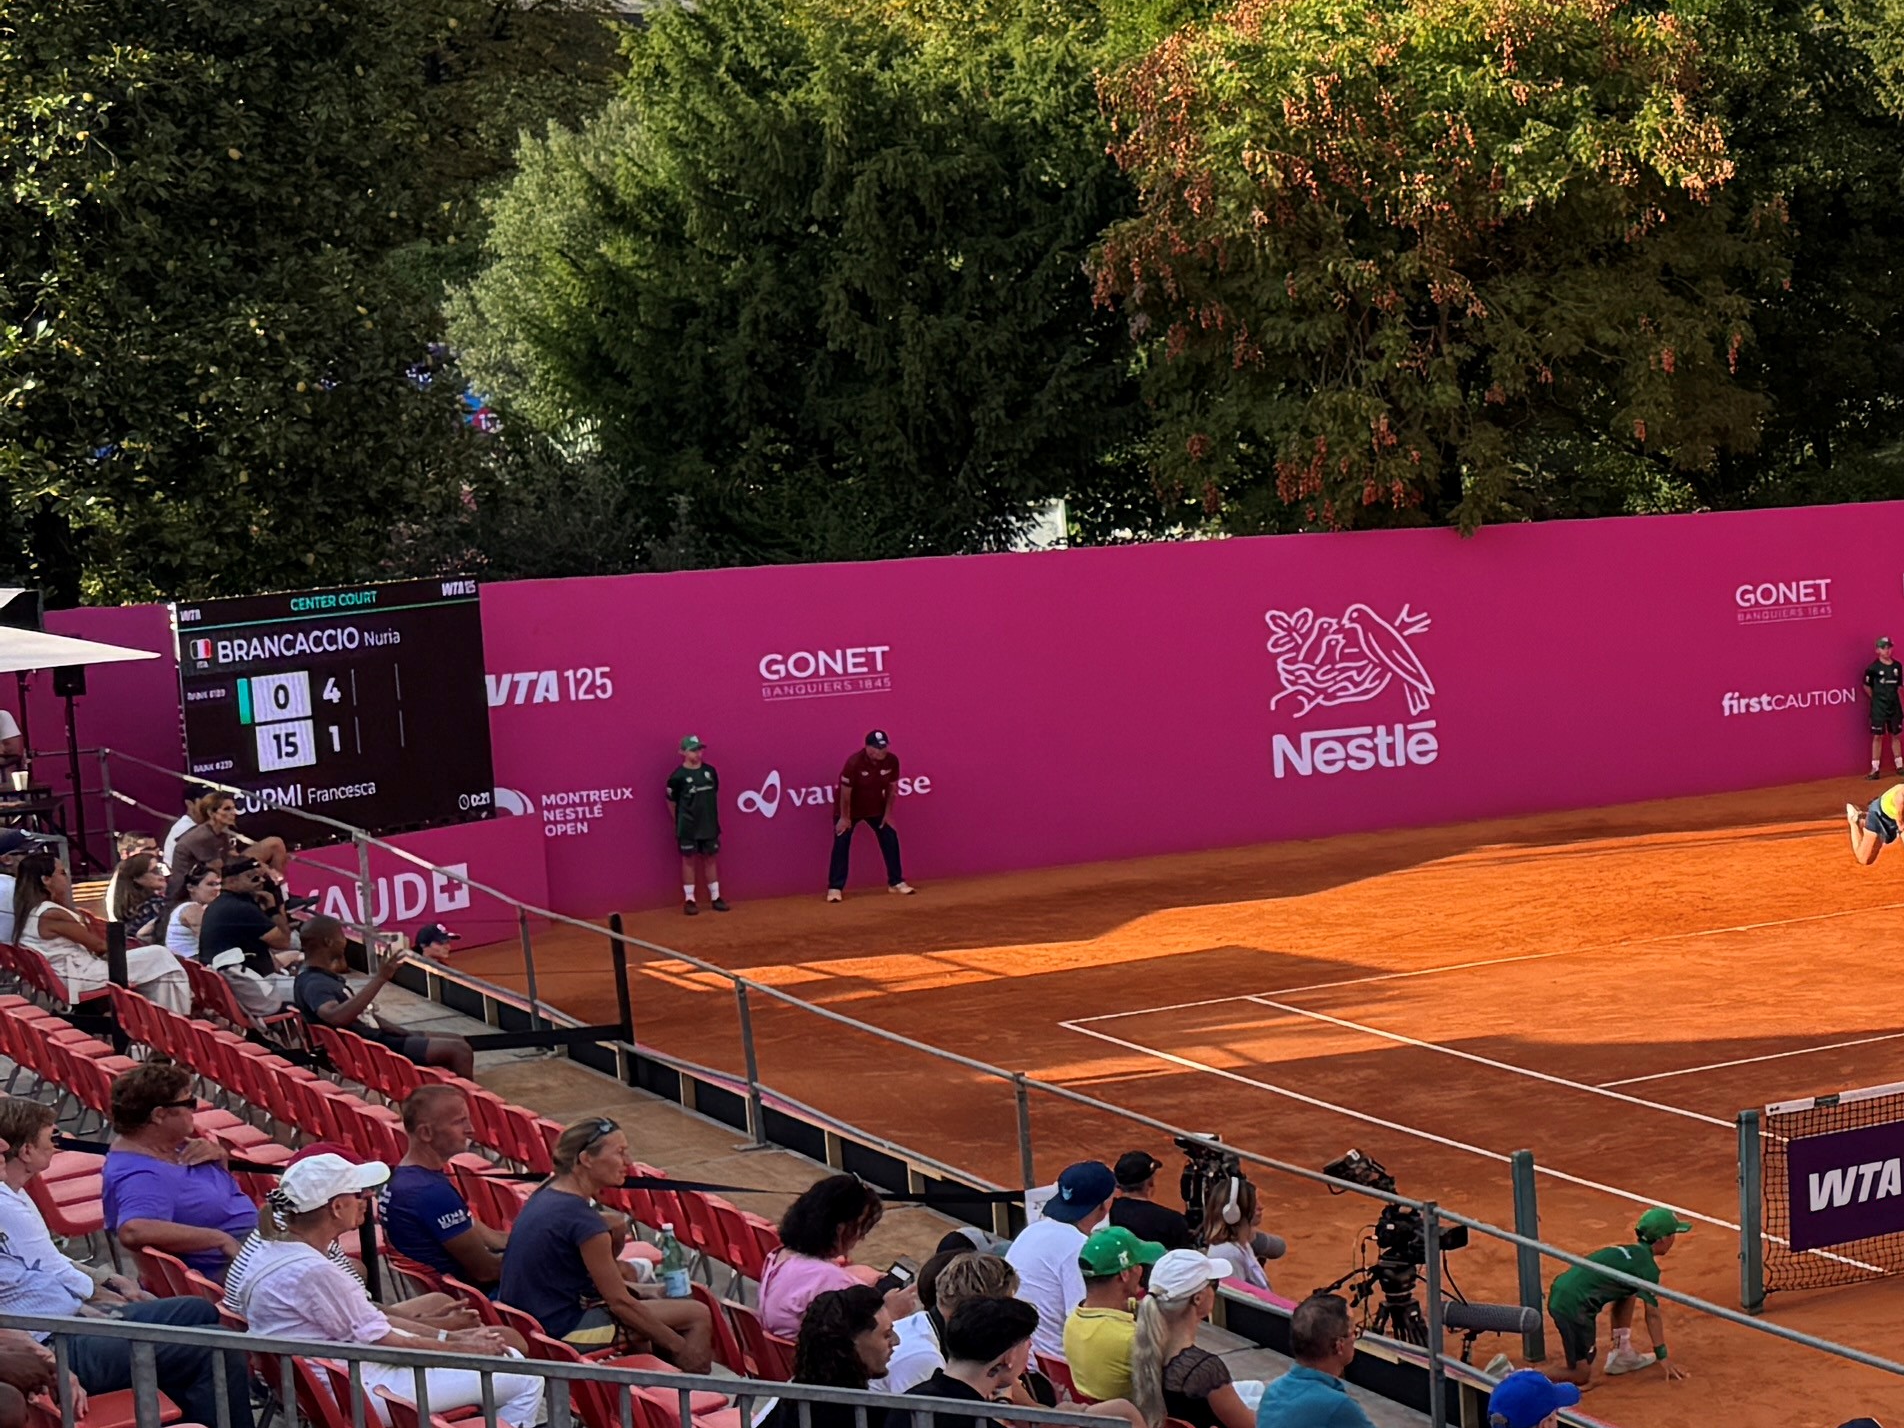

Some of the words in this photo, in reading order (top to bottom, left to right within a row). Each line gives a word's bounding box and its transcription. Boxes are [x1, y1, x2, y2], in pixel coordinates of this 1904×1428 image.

[291, 593, 336, 611] CENTER
[338, 590, 377, 607] COURT
[1736, 578, 1831, 608] GONET
[1738, 608, 1803, 622] BANQUIERS
[217, 626, 359, 664] BRANCACCIO
[364, 630, 400, 647] Nuria
[759, 645, 889, 681] GONET
[273, 684, 289, 710] 0
[322, 678, 341, 703] 4
[565, 667, 613, 701] 125
[761, 680, 852, 699] BANQUIERS
[858, 677, 892, 690] 1845
[1722, 688, 1856, 716] firstCAUTION
[272, 732, 299, 759] 15
[329, 725, 340, 752] 1
[1273, 719, 1439, 778] Nestlé
[308, 780, 376, 805] Francesca
[541, 787, 633, 806] MONTREUX
[787, 775, 931, 806] vause
[543, 805, 603, 822] NESTLÉ
[545, 822, 588, 837] OPEN
[1808, 1158, 1901, 1212] WTA
